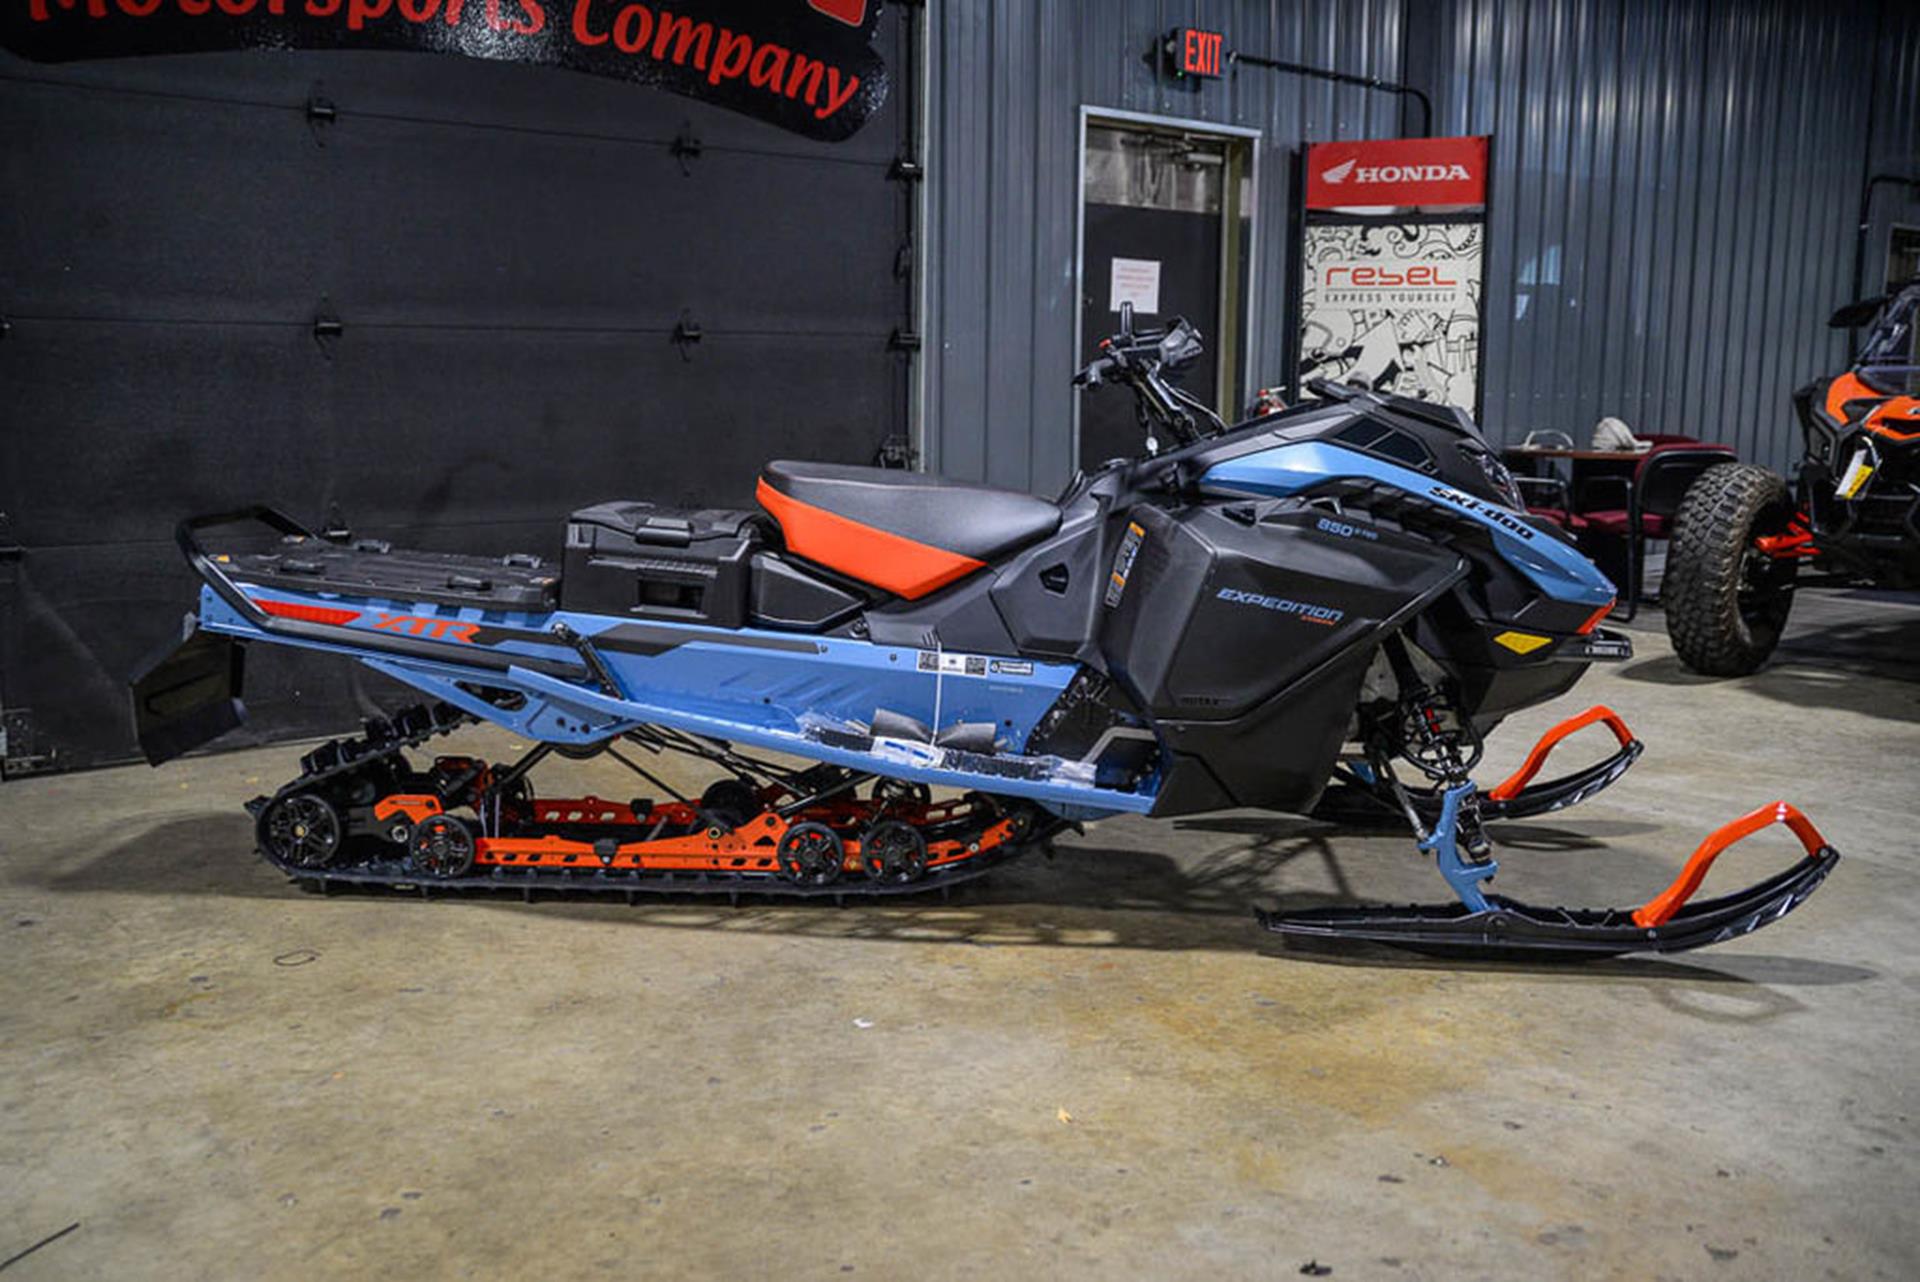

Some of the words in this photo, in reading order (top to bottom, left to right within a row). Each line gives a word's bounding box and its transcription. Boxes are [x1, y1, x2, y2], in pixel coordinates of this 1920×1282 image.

[572, 0, 859, 118] Company
[1185, 30, 1222, 76] EXIT
[1355, 165, 1470, 183] HONDA
[1324, 293, 1382, 303] EXPRESS
[1390, 293, 1456, 302] YOURSELF
[1216, 587, 1344, 621] EXPEDITION
[372, 612, 481, 643] XTR
